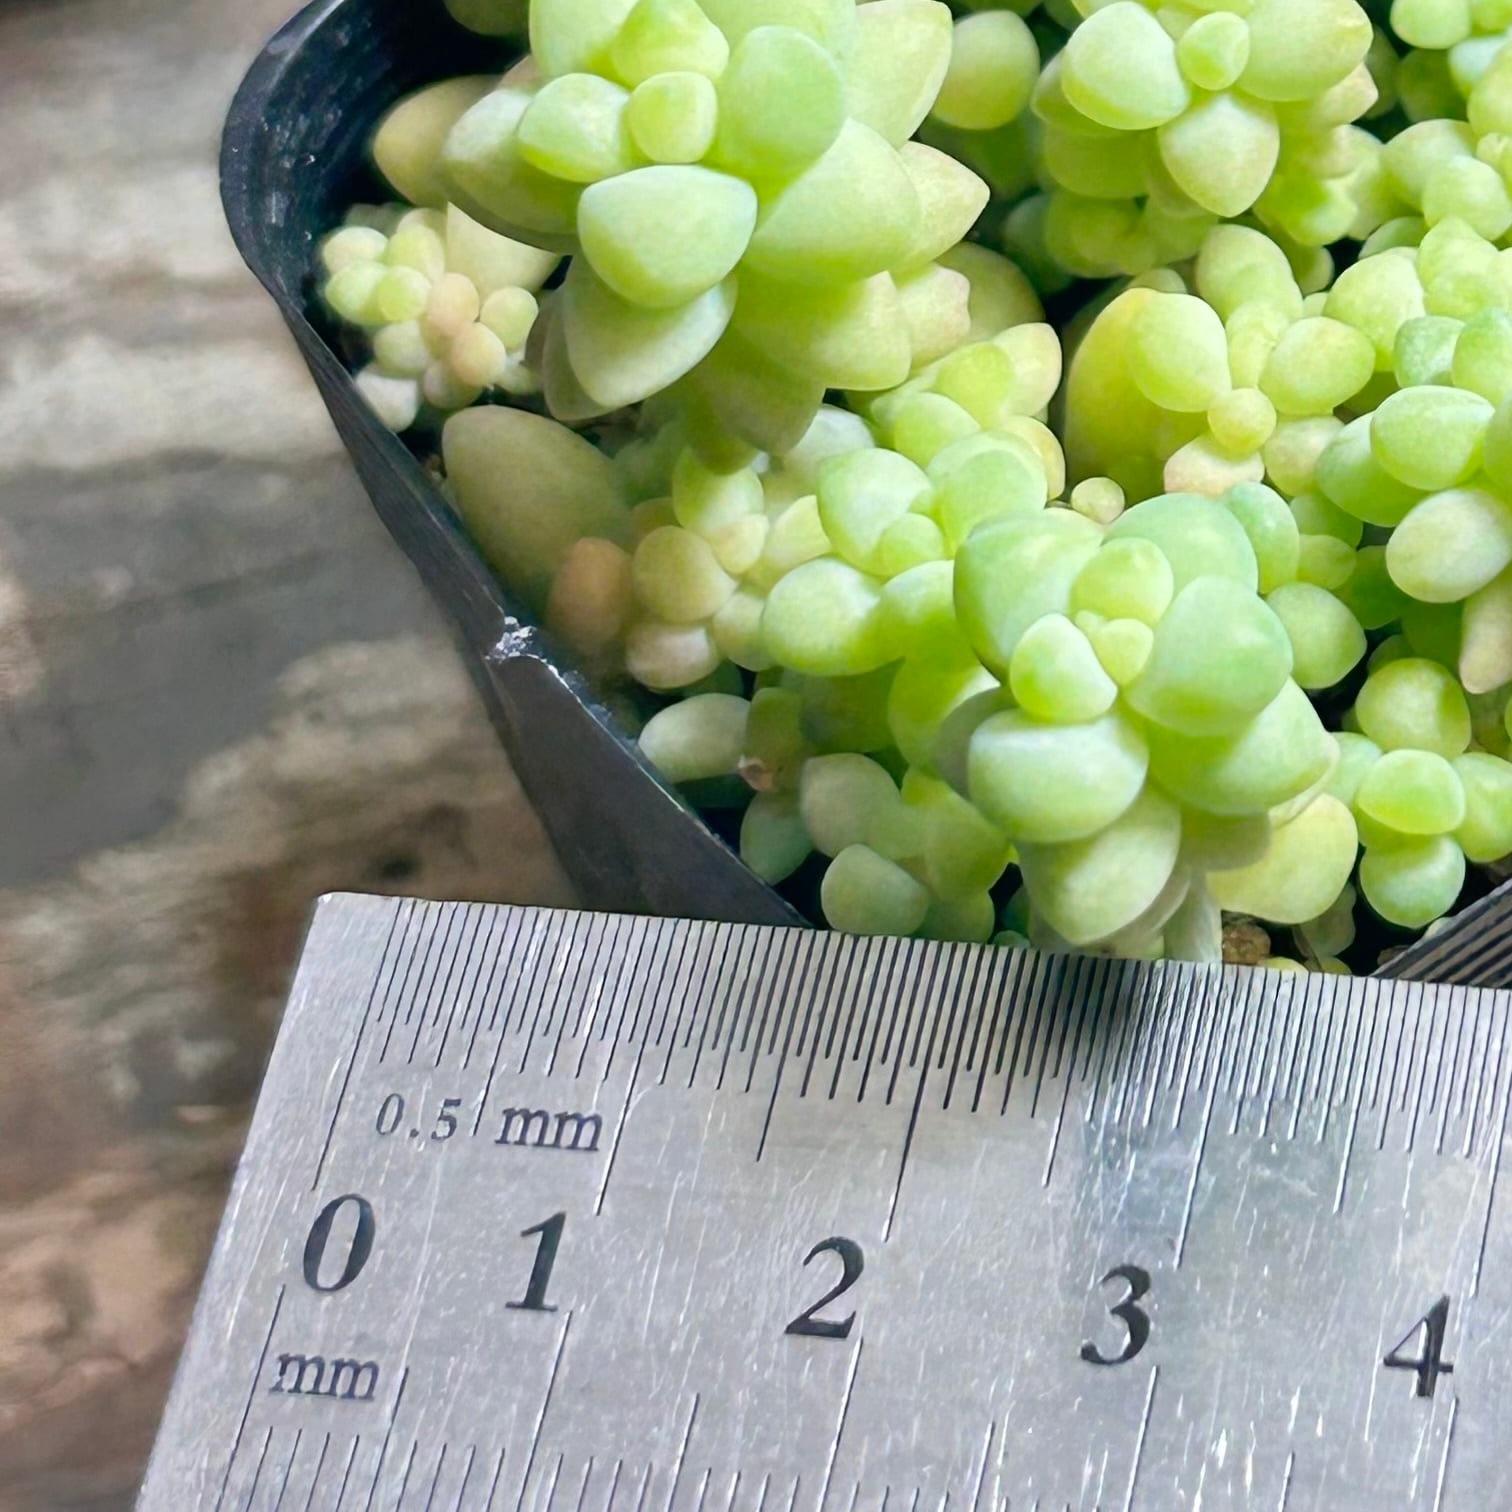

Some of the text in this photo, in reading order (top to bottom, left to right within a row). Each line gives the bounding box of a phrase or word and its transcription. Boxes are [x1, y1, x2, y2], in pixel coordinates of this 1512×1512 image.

[376, 1092, 603, 1152] 0.5 mm
[302, 1192, 377, 1292] 0
[505, 1210, 568, 1313] 1
[783, 1235, 865, 1339] 2
[1080, 1262, 1152, 1366] 3
[1382, 1293, 1455, 1398] 4
[267, 1350, 381, 1402] mm
